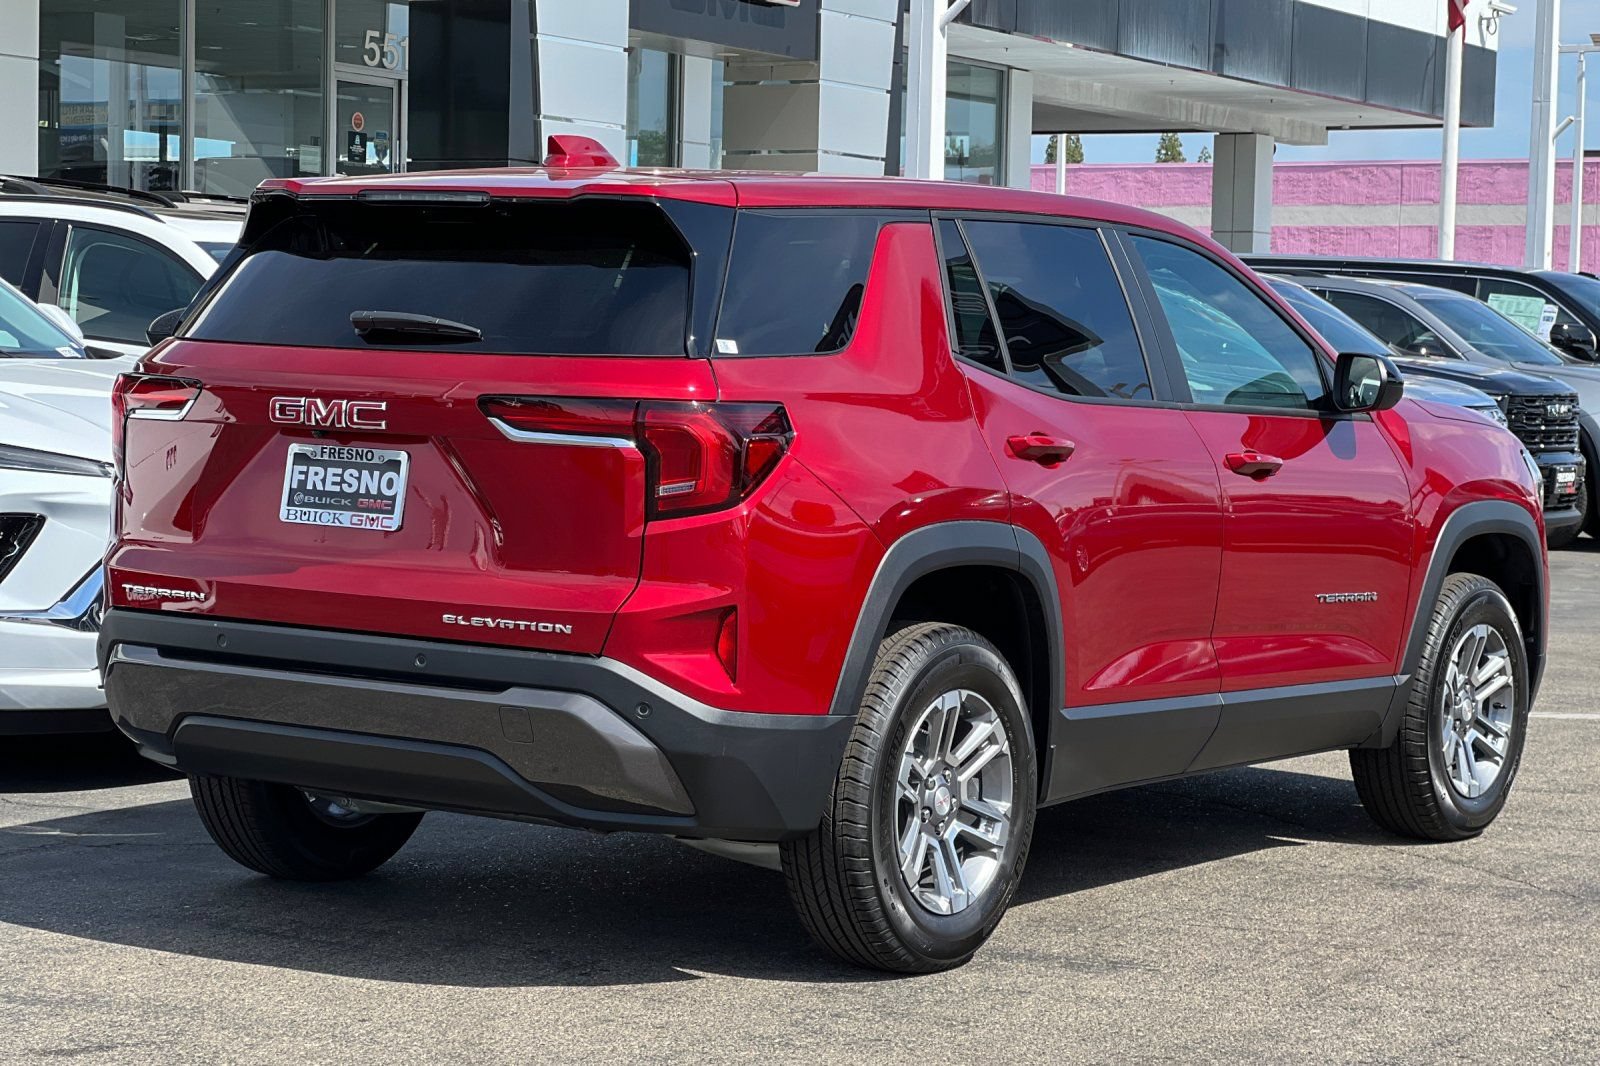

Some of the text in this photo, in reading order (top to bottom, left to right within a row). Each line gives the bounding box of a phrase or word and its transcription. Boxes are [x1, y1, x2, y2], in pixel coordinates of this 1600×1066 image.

[269, 396, 386, 430] GMC
[320, 446, 375, 462] FRESNO
[291, 465, 400, 497] FRESNO
[304, 496, 393, 510] BUICK GMC
[285, 508, 394, 529] BUICK GMC
[122, 584, 206, 601] TERRAIN
[1315, 592, 1378, 603] TERRAIN
[442, 614, 573, 635] ELEVATION
